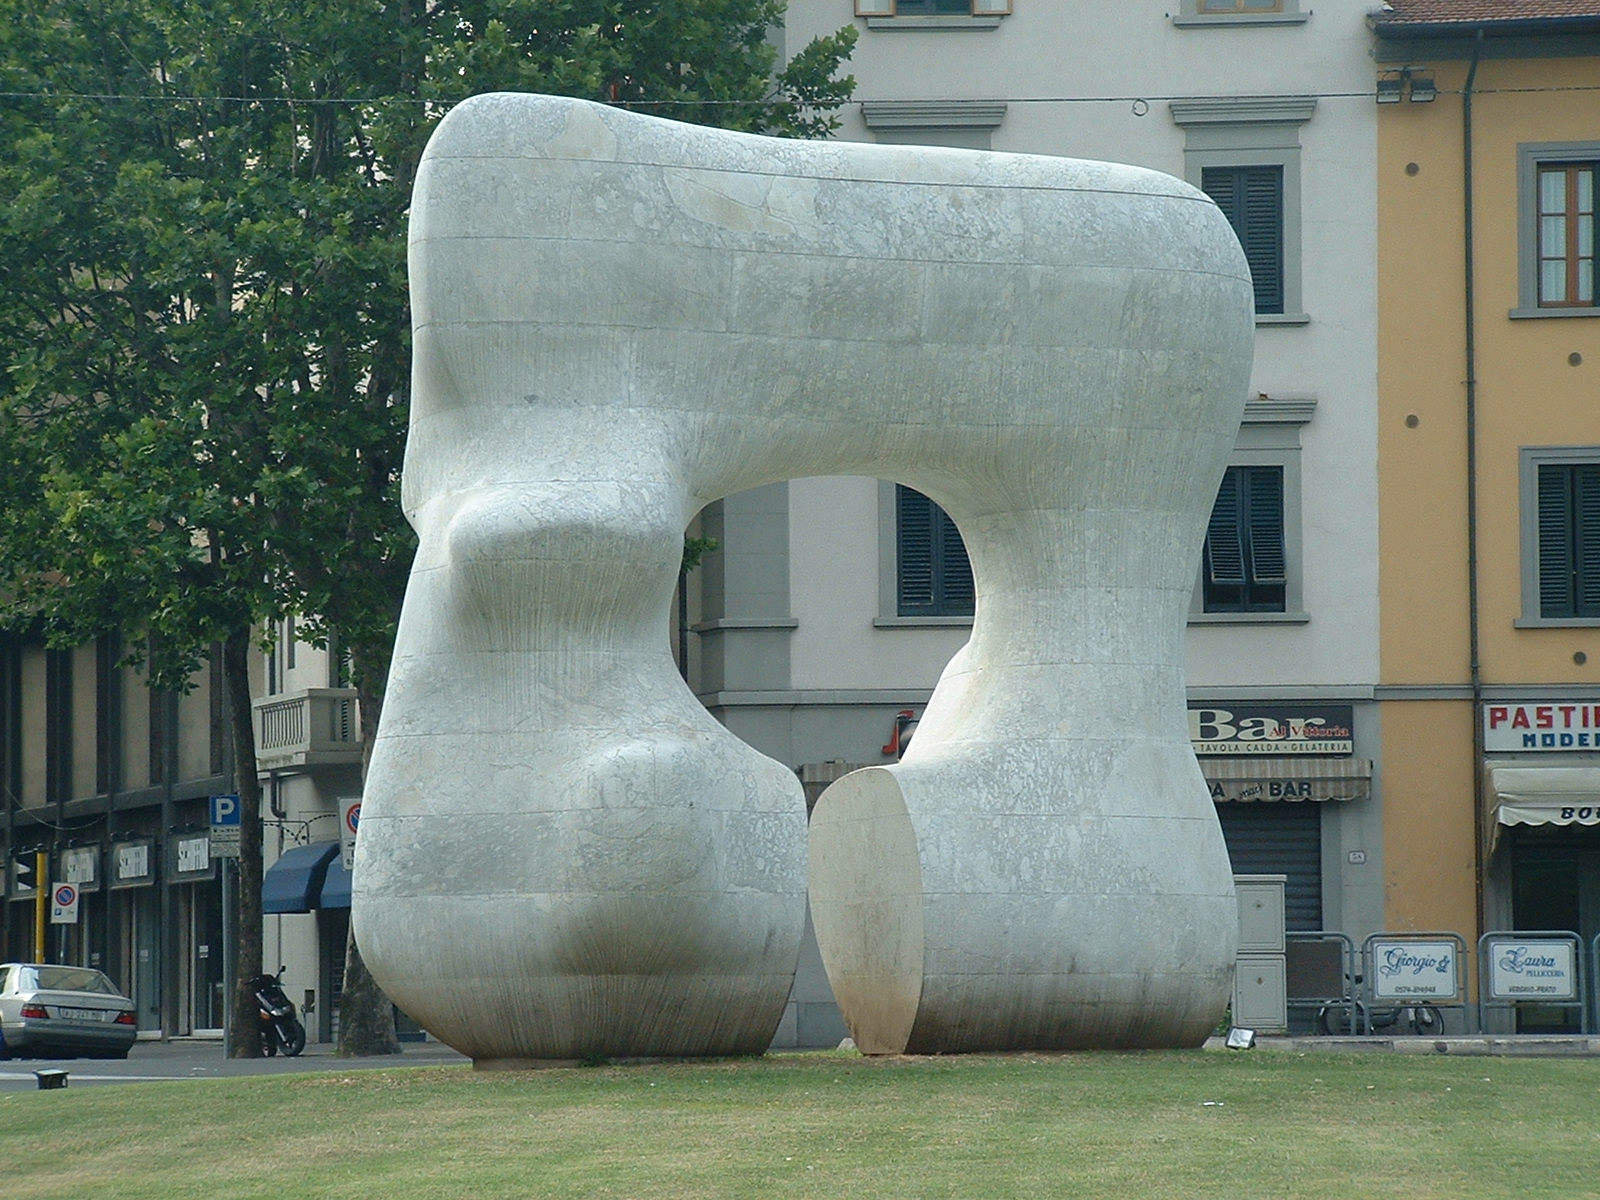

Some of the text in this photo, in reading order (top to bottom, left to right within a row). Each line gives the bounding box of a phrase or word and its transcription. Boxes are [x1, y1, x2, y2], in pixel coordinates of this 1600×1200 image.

[1187, 709, 1326, 741] Bar
[1201, 742, 1348, 752] TAVOLA CALDA GELATERIA
[1269, 782, 1313, 797] BAR
[216, 798, 235, 823] P
[1379, 947, 1436, 979] Giorgio
[1500, 947, 1556, 974] Laura
